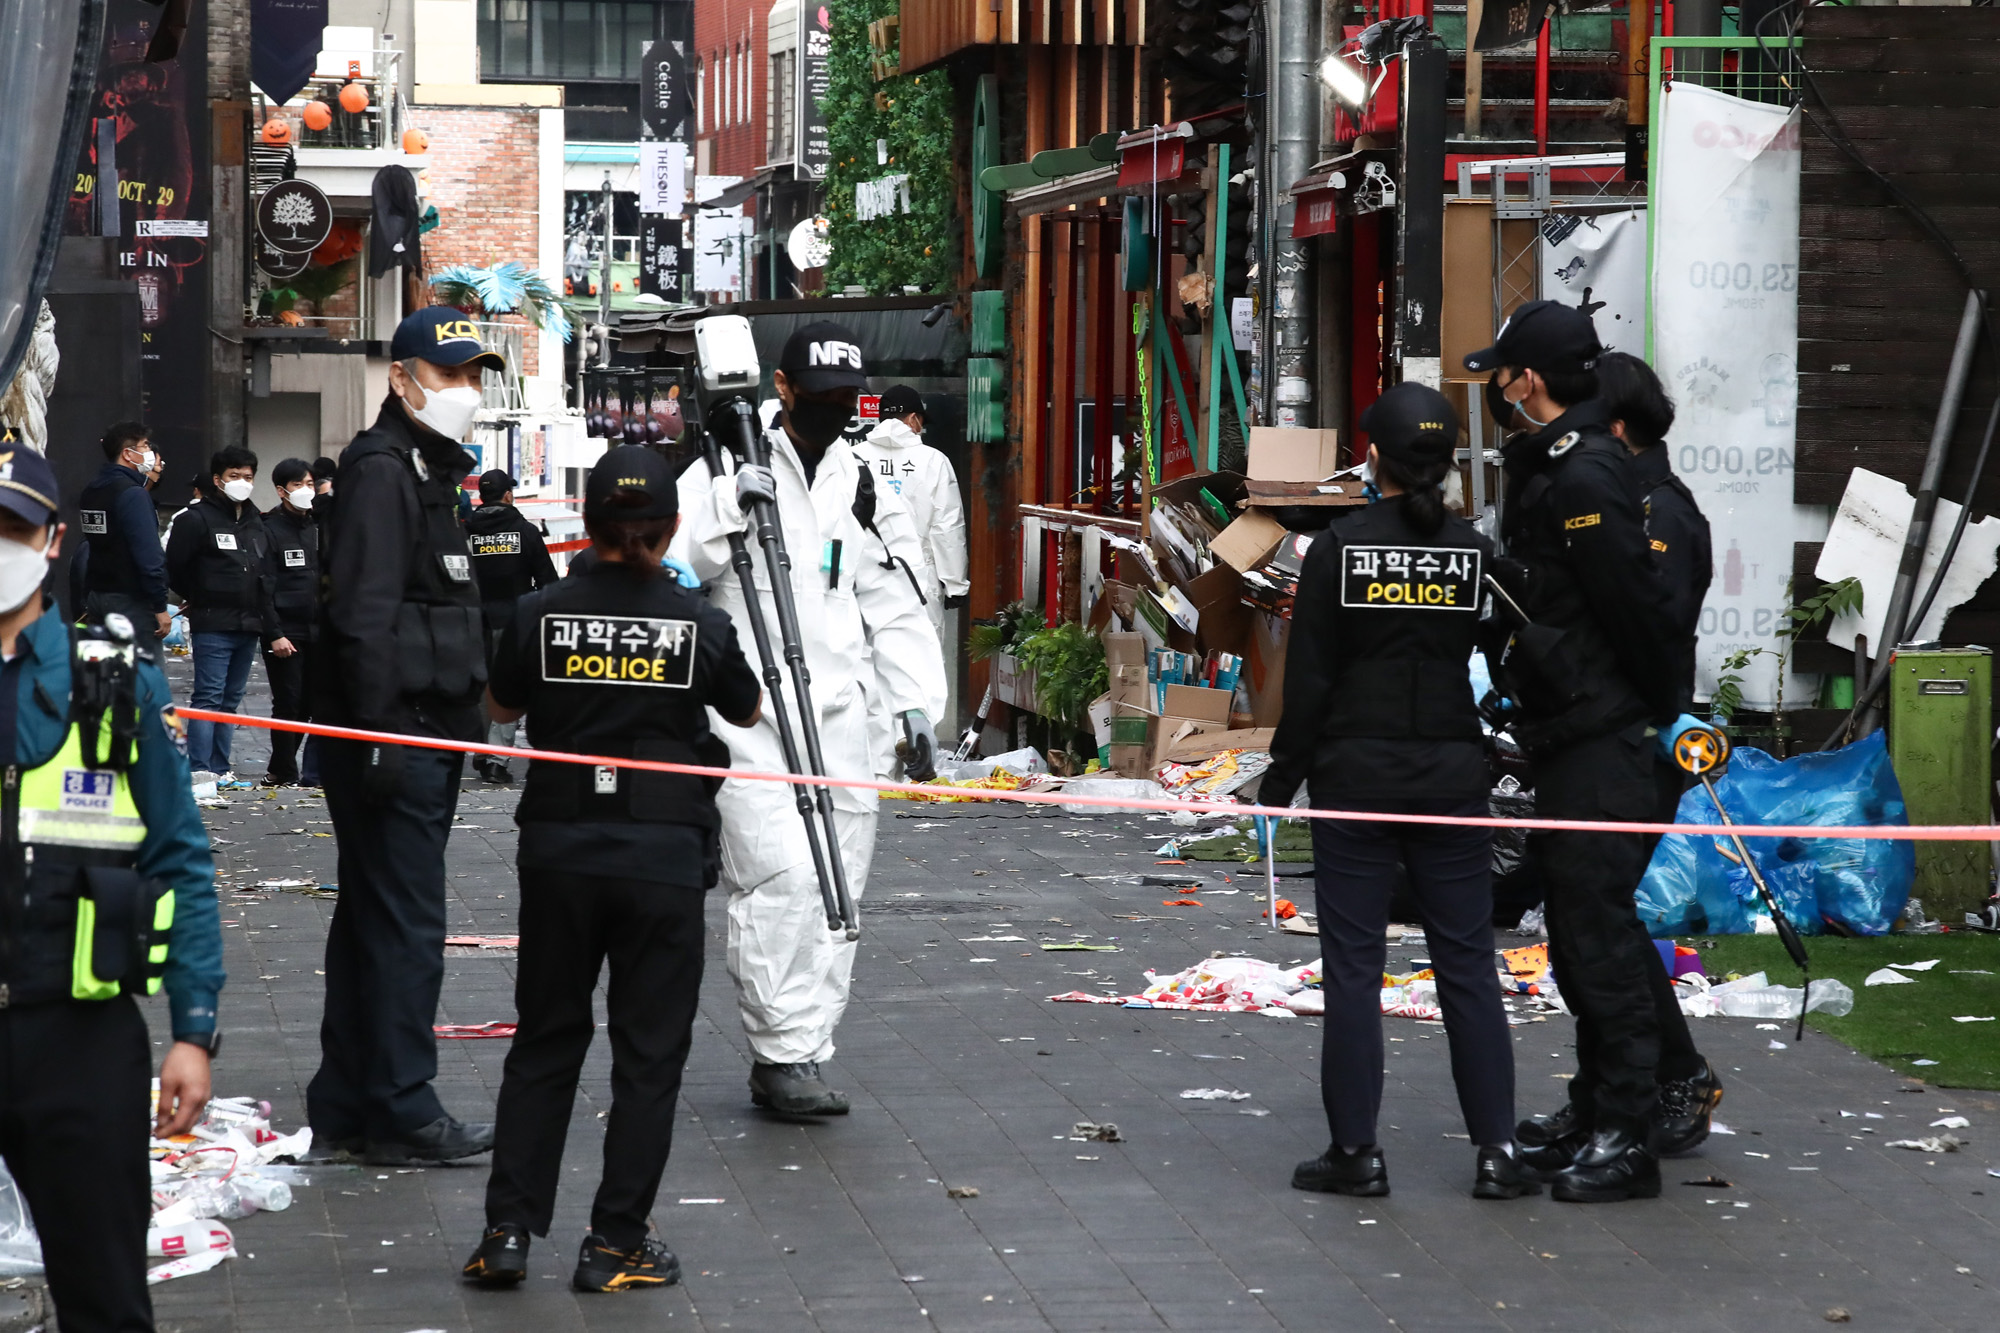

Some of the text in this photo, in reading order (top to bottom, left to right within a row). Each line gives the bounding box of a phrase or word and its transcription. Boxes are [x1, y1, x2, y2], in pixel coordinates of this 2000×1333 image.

[659, 61, 672, 109] Cécile
[157, 186, 175, 207] 29
[657, 245, 678, 290] 鐵板
[809, 341, 862, 369] NFS
[1565, 513, 1600, 530] KCSI
[473, 534, 517, 546] 과학수사
[480, 545, 513, 554] POLICE
[1352, 551, 1472, 582] 과학수사
[1367, 582, 1457, 605] POLICE
[551, 621, 685, 656] 과학수사
[566, 655, 667, 682] POLICE
[65, 797, 108, 809] POLICE
